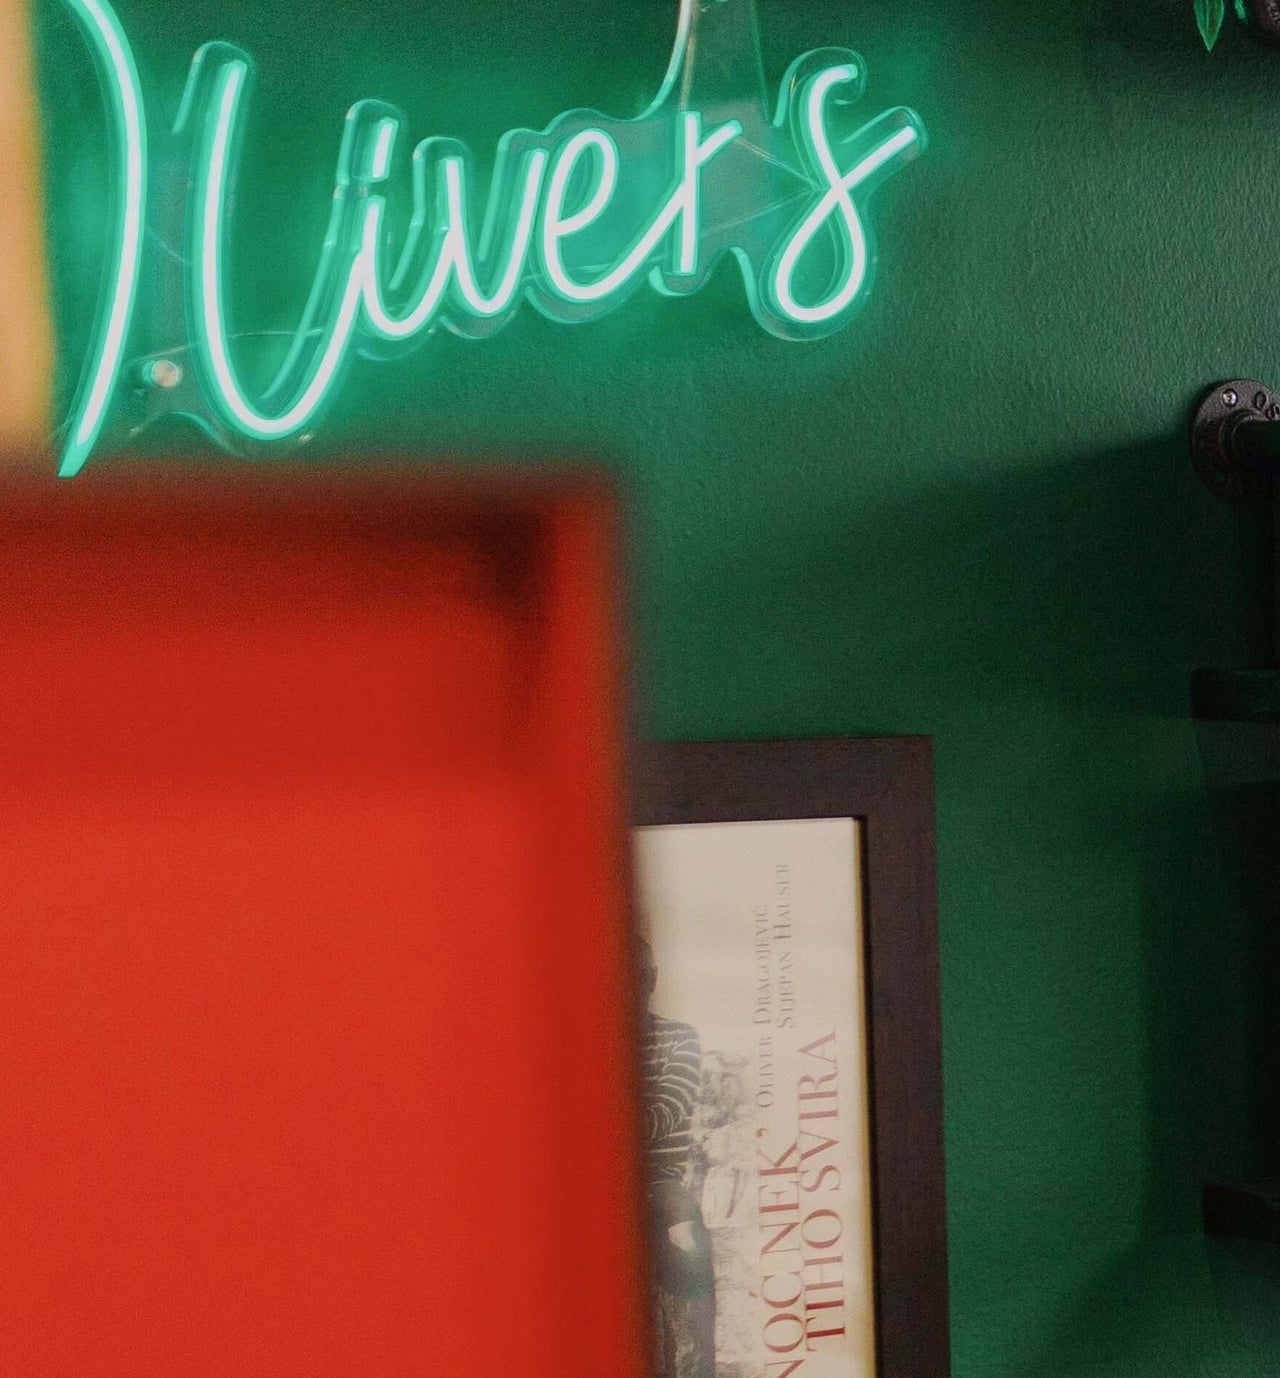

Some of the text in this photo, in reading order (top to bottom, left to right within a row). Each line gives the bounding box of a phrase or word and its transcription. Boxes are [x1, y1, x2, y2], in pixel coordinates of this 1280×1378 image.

[772, 862, 792, 941] HAUSER
[756, 1034, 774, 1109] OLIVER
[798, 1031, 845, 1351] TIHO SVIRA
